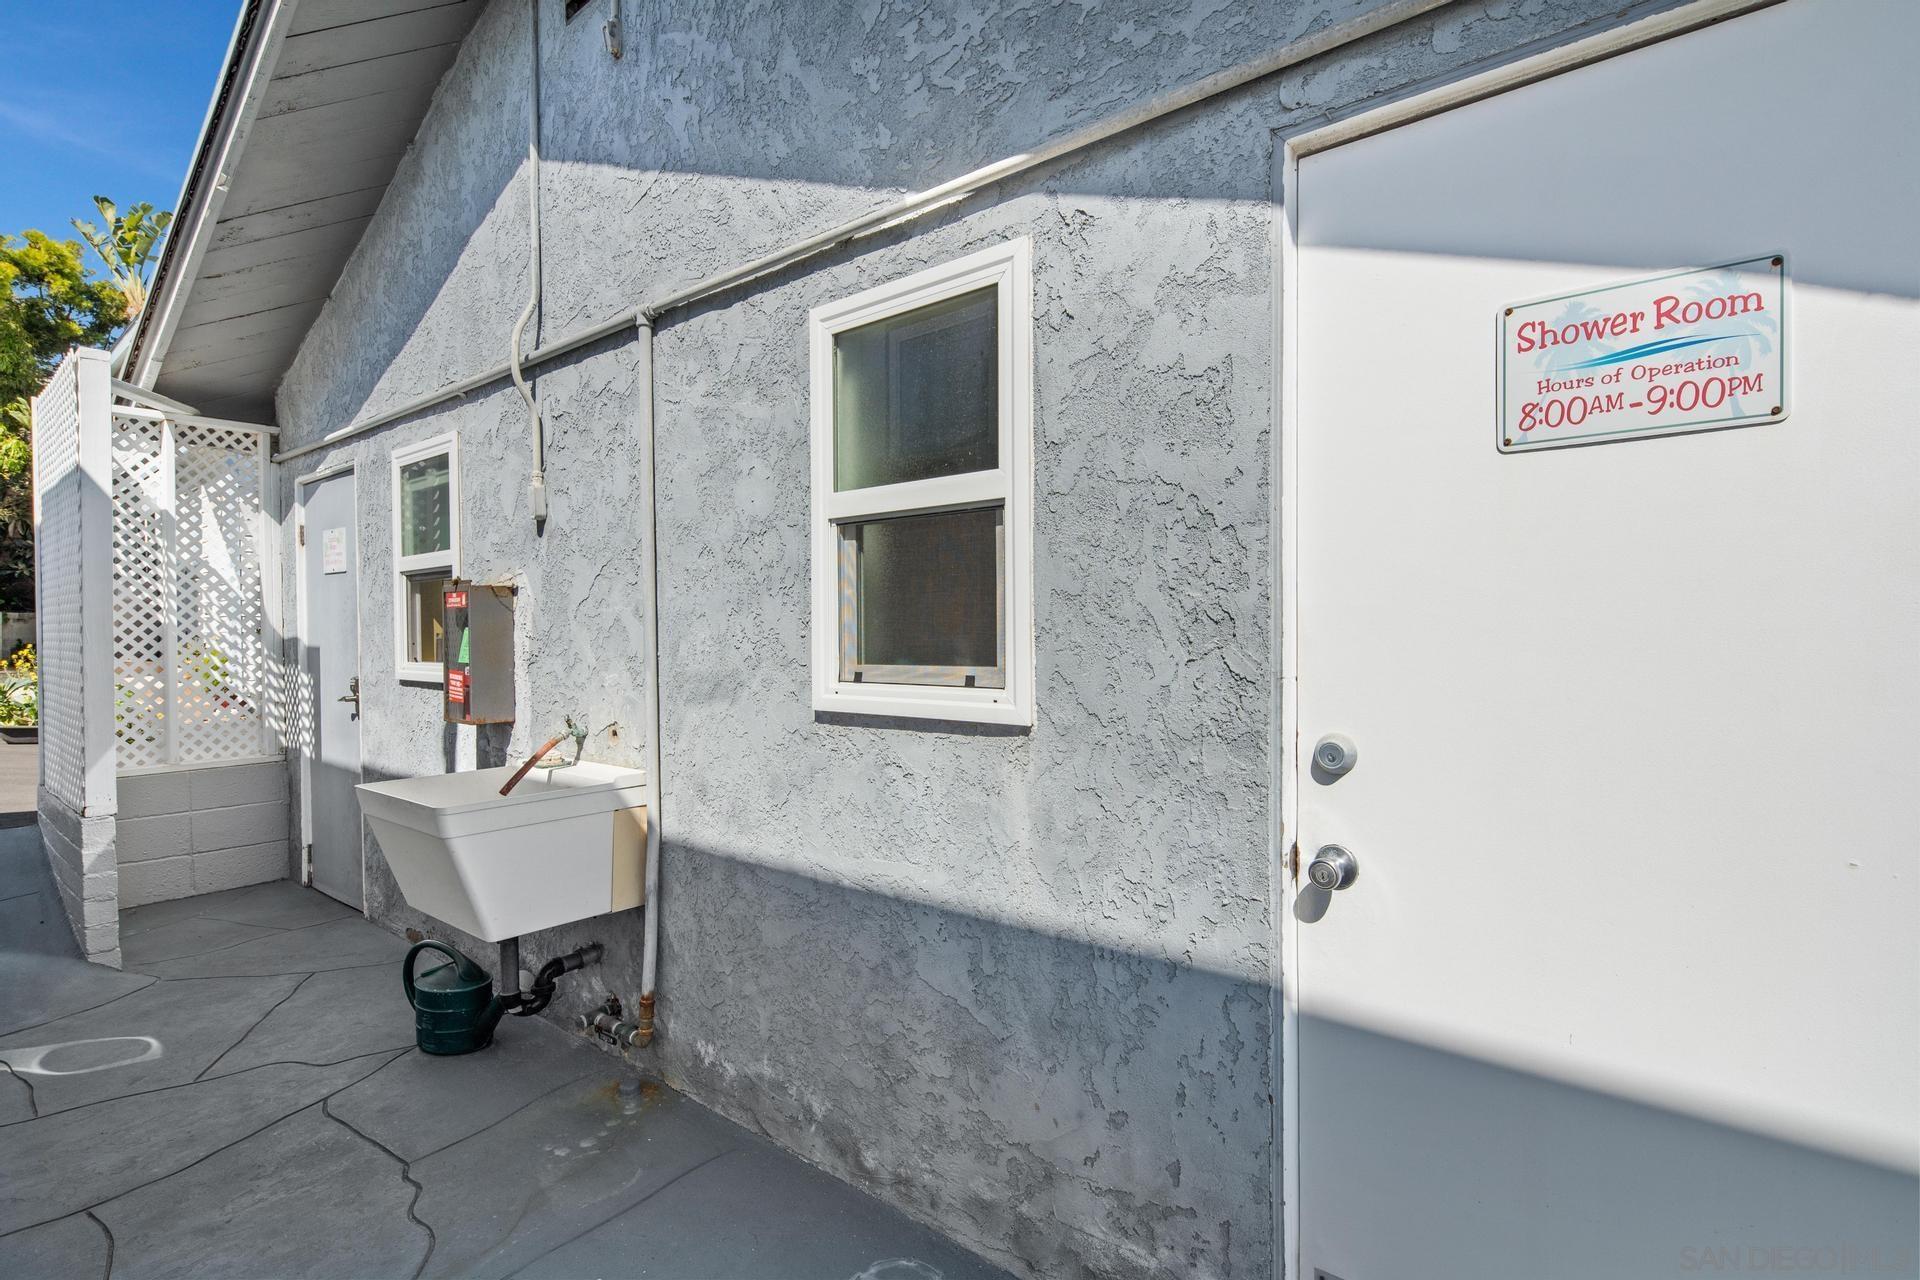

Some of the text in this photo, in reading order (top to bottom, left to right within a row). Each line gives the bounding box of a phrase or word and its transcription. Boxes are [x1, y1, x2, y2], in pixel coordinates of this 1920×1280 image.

[1517, 291, 1765, 354] Shower Room
[1536, 354, 1740, 395] Hours of Operation
